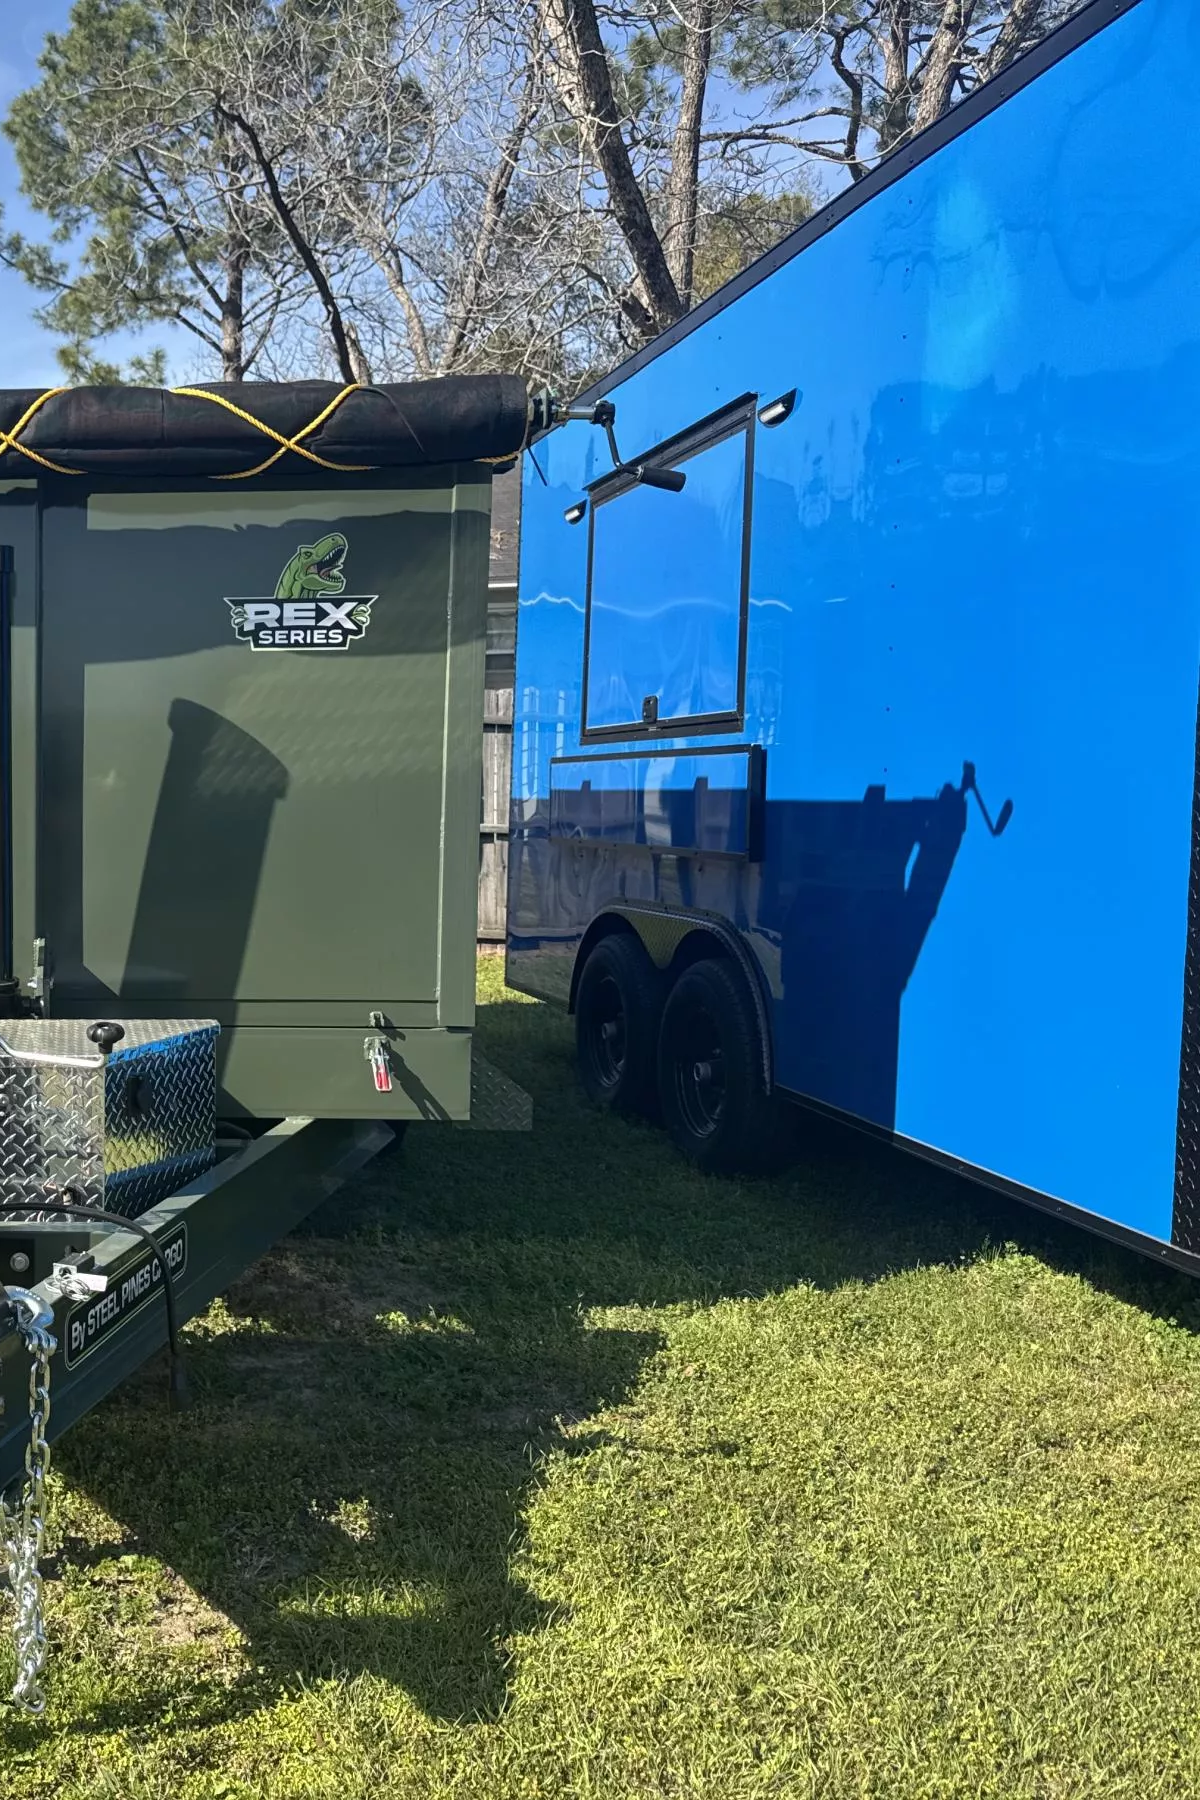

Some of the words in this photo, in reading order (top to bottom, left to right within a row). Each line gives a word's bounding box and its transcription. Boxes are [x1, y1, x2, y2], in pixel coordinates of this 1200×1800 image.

[243, 602, 359, 631] REX
[258, 629, 343, 644] SERIES
[72, 1320, 86, 1350] By
[87, 1290, 120, 1336] STEEL
[121, 1264, 151, 1309] PINES
